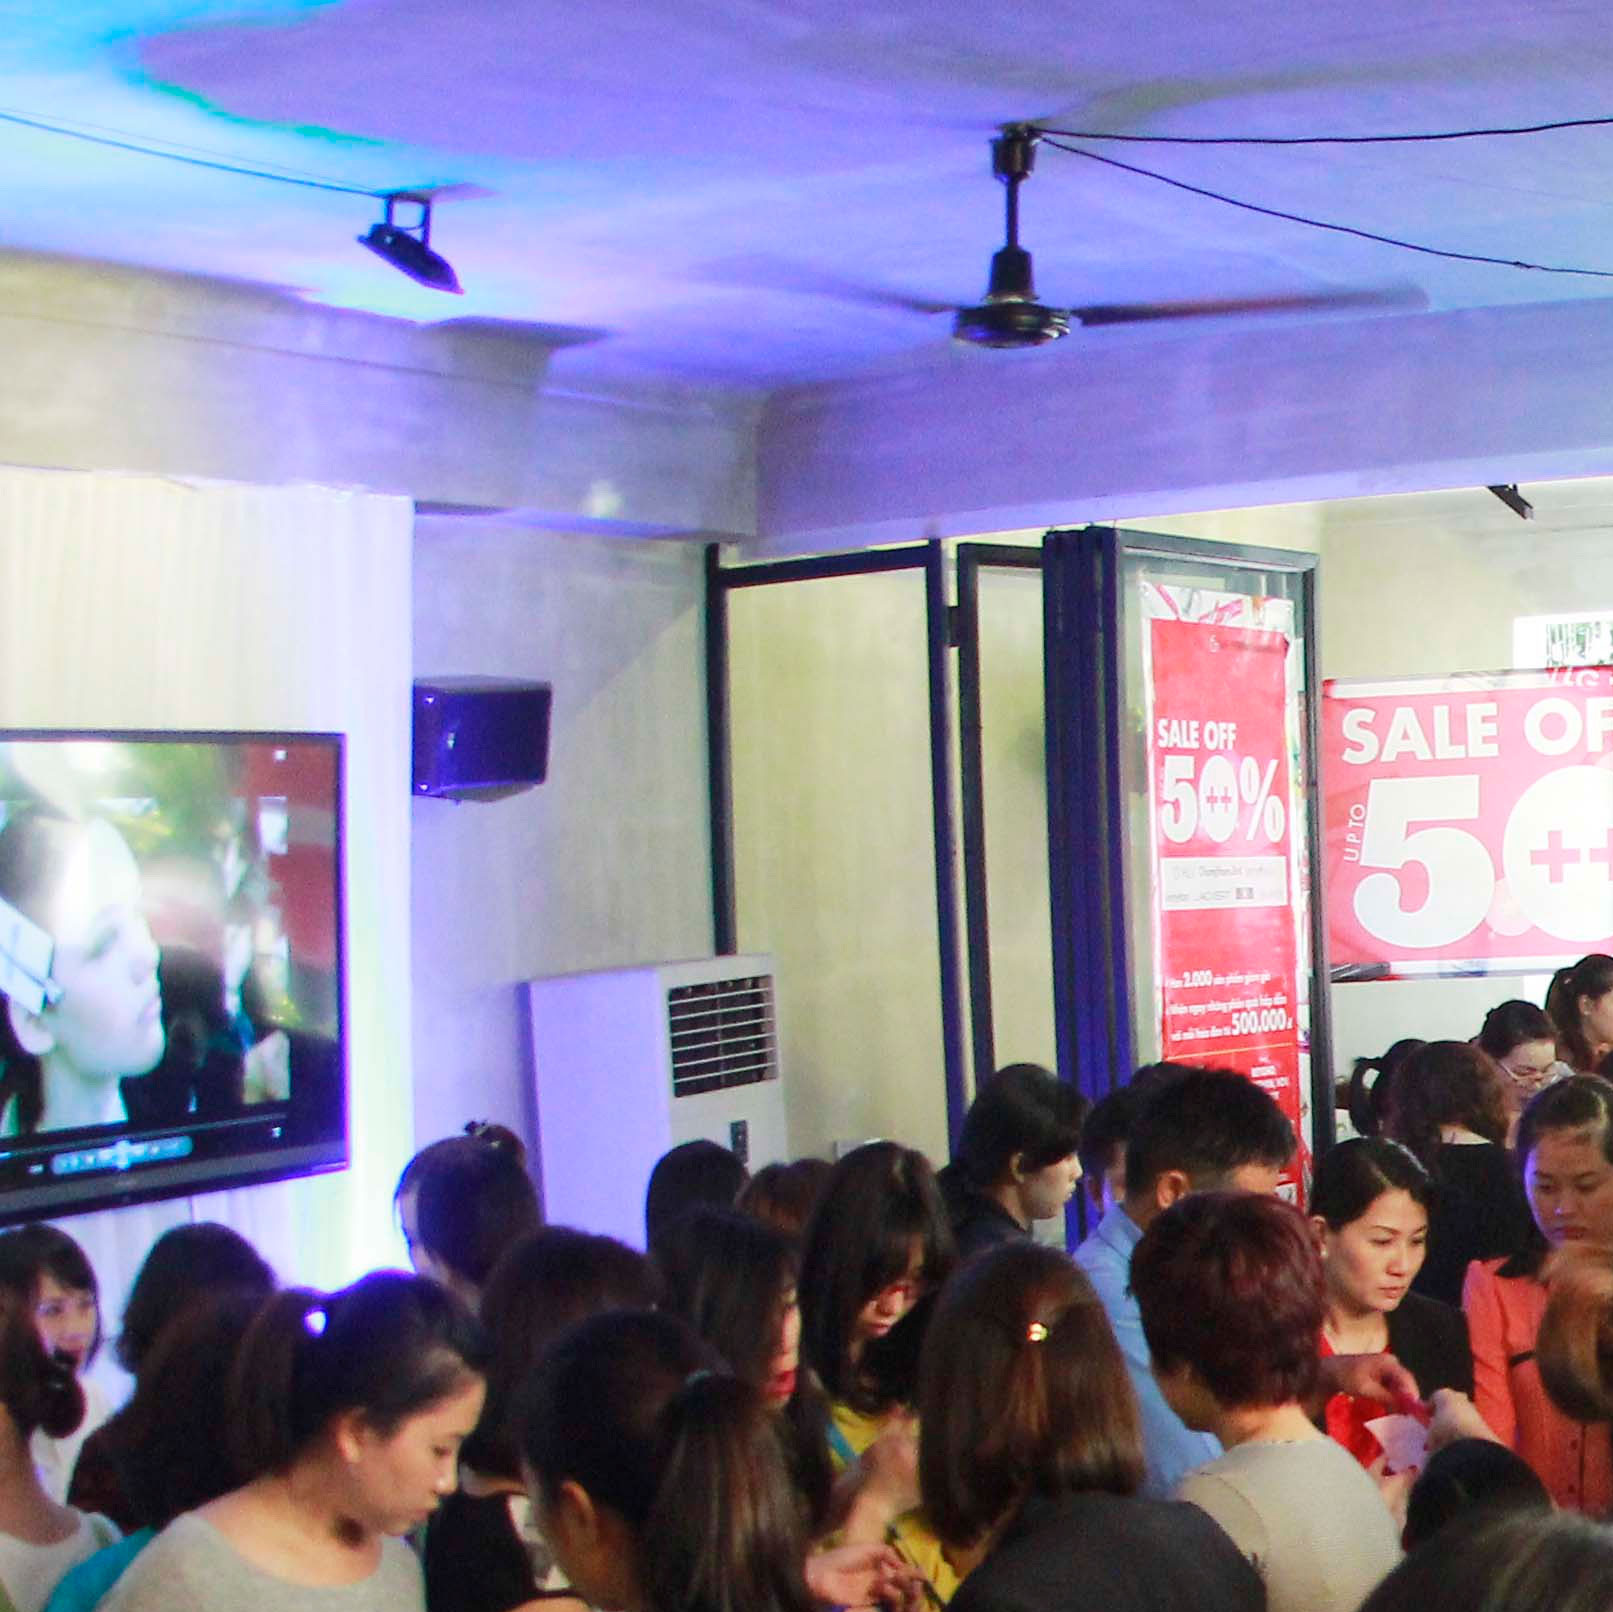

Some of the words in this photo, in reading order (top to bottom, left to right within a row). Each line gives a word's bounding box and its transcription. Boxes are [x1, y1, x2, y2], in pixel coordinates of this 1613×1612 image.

[1157, 718, 1200, 749] SALE
[1203, 720, 1237, 750] OFF
[1341, 701, 1499, 765] SALE
[1347, 803, 1367, 828] TO
[1343, 832, 1361, 863] UP
[1231, 1008, 1287, 1036] 500.000
